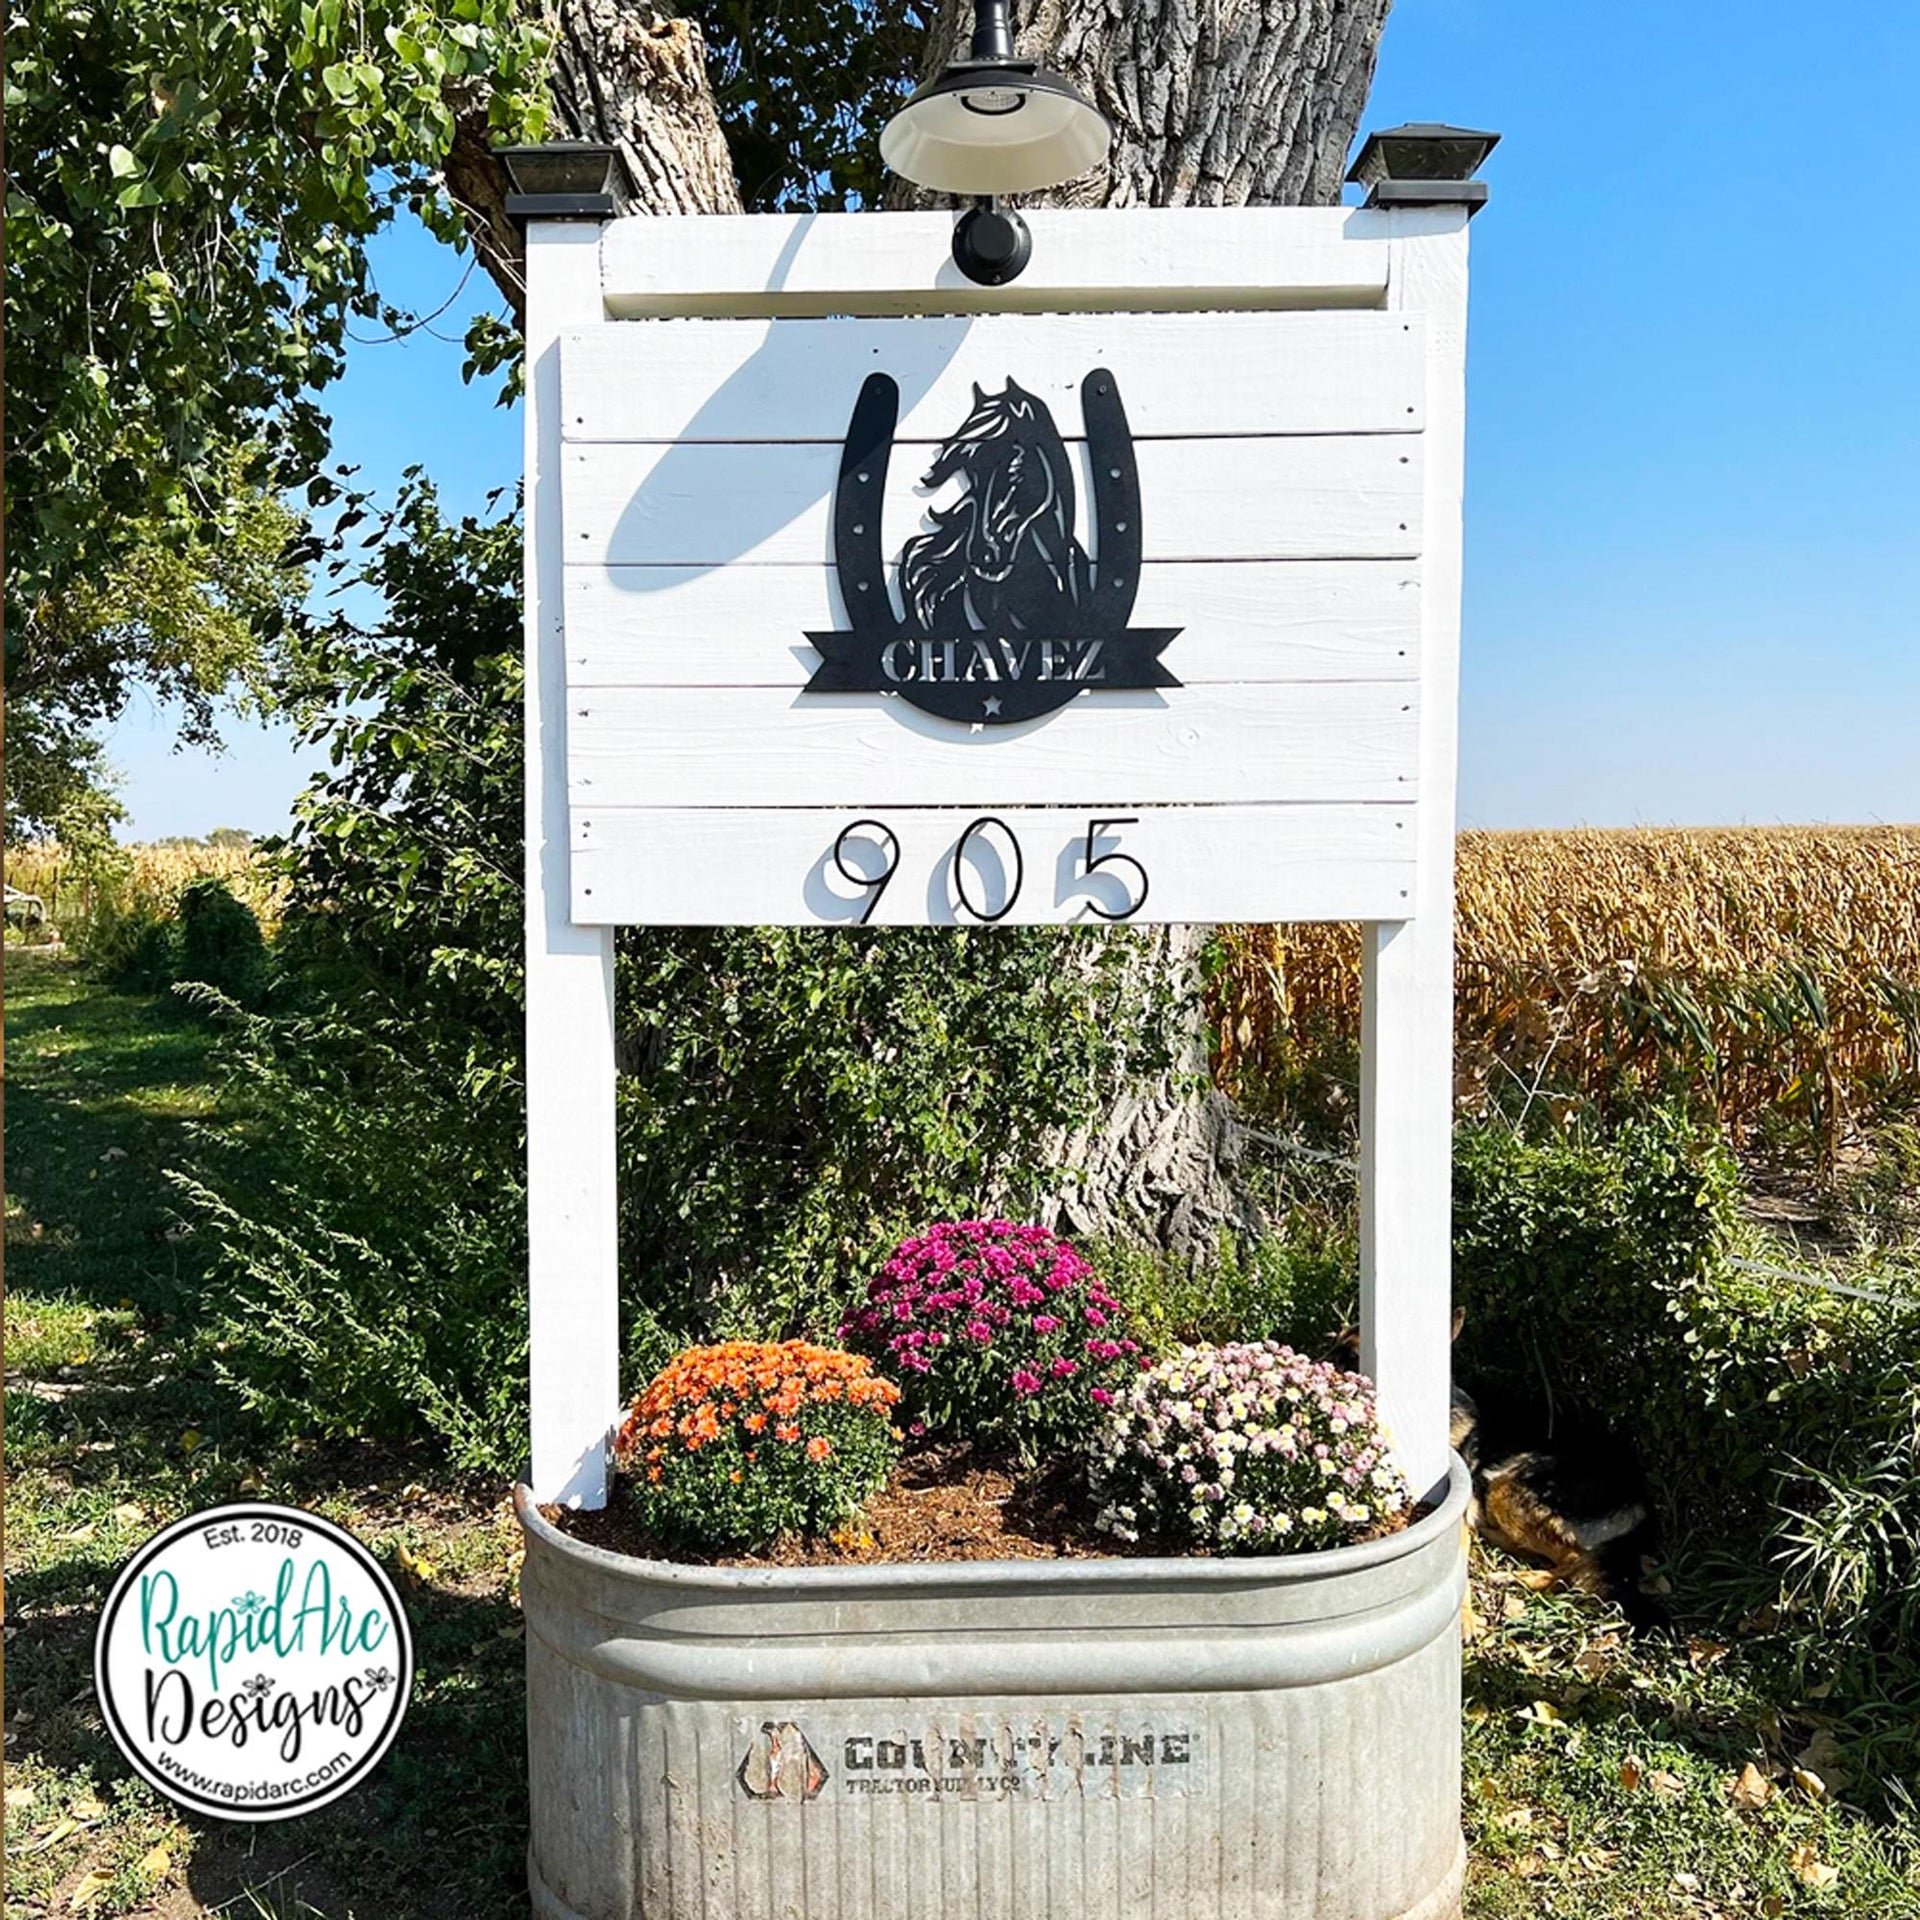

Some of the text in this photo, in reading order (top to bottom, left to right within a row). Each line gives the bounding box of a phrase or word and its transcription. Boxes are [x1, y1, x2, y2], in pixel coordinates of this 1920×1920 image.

[880, 638, 1106, 683] CHAVEZ
[833, 816, 1149, 925] 905
[846, 1777, 931, 1794] TRACTOR
